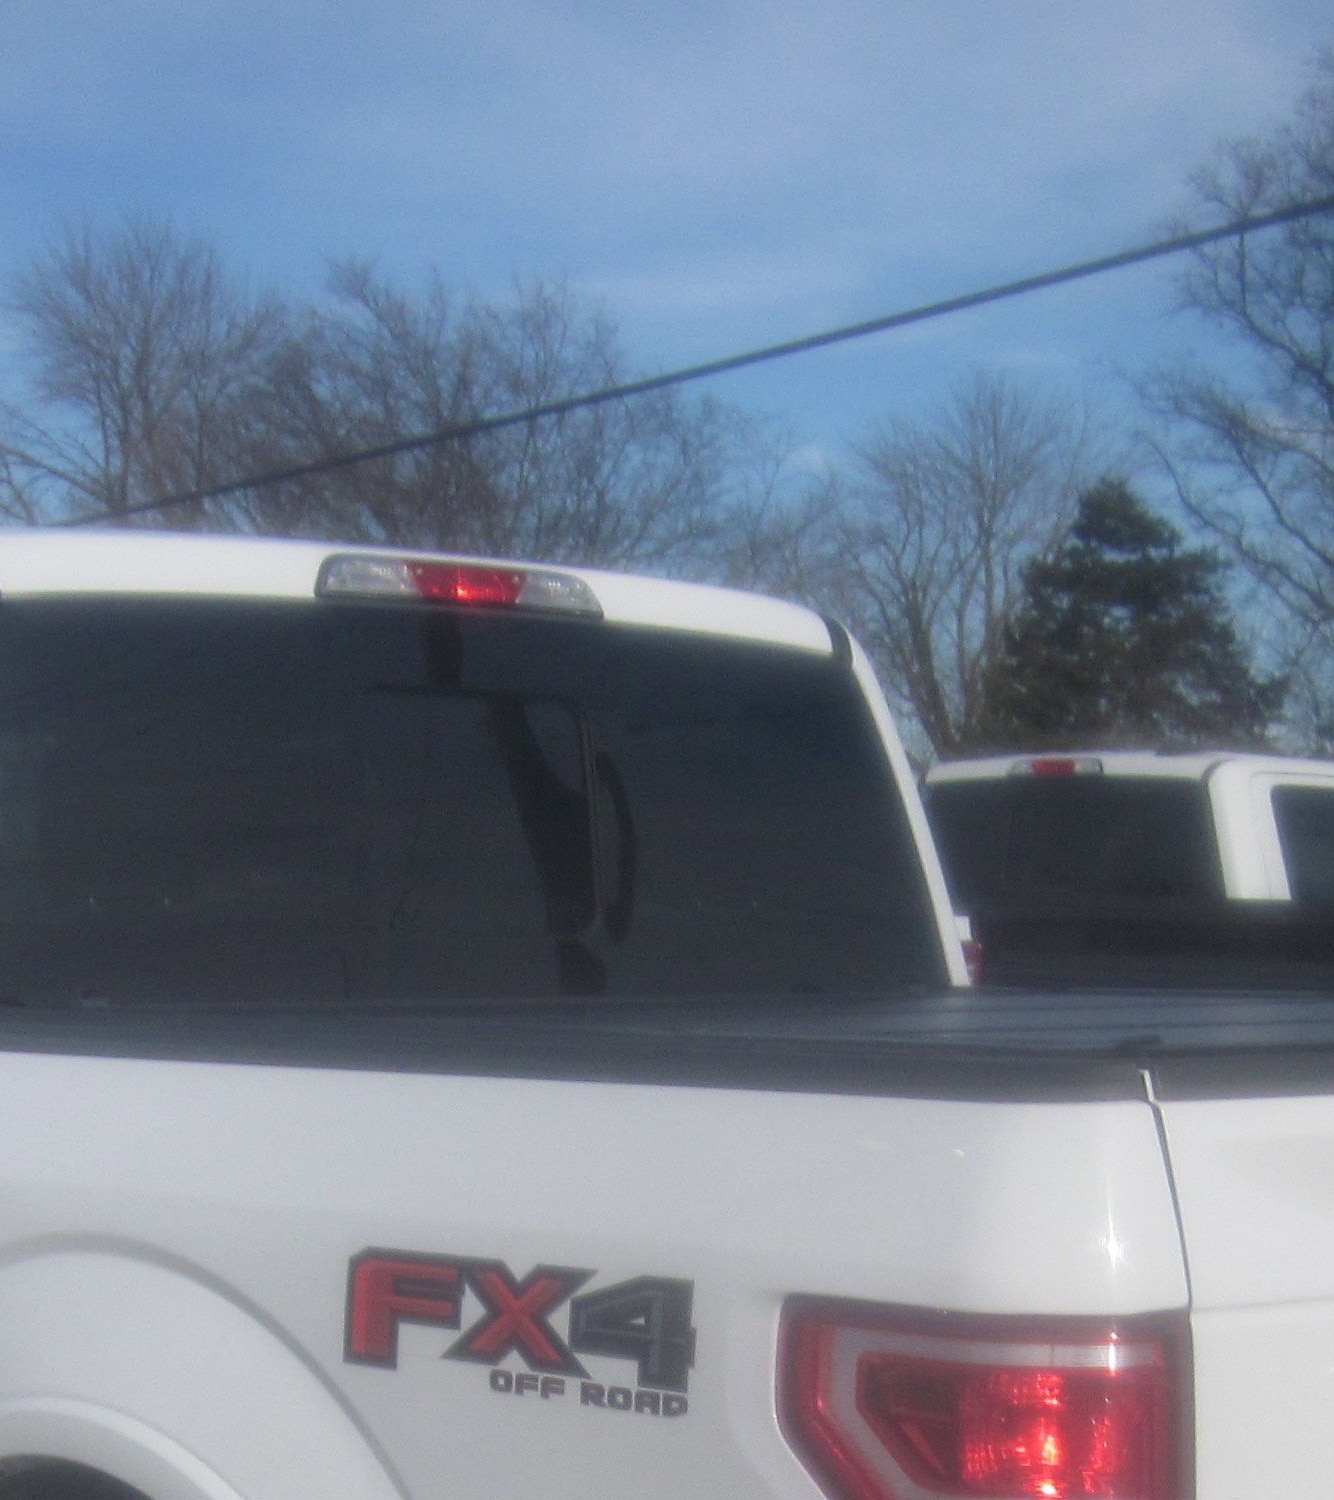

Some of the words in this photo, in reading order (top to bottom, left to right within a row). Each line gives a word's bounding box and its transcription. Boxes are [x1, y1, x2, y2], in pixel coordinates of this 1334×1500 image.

[343, 1246, 695, 1393] FX4
[489, 1369, 565, 1399] OFF
[579, 1380, 689, 1416] ROAD
